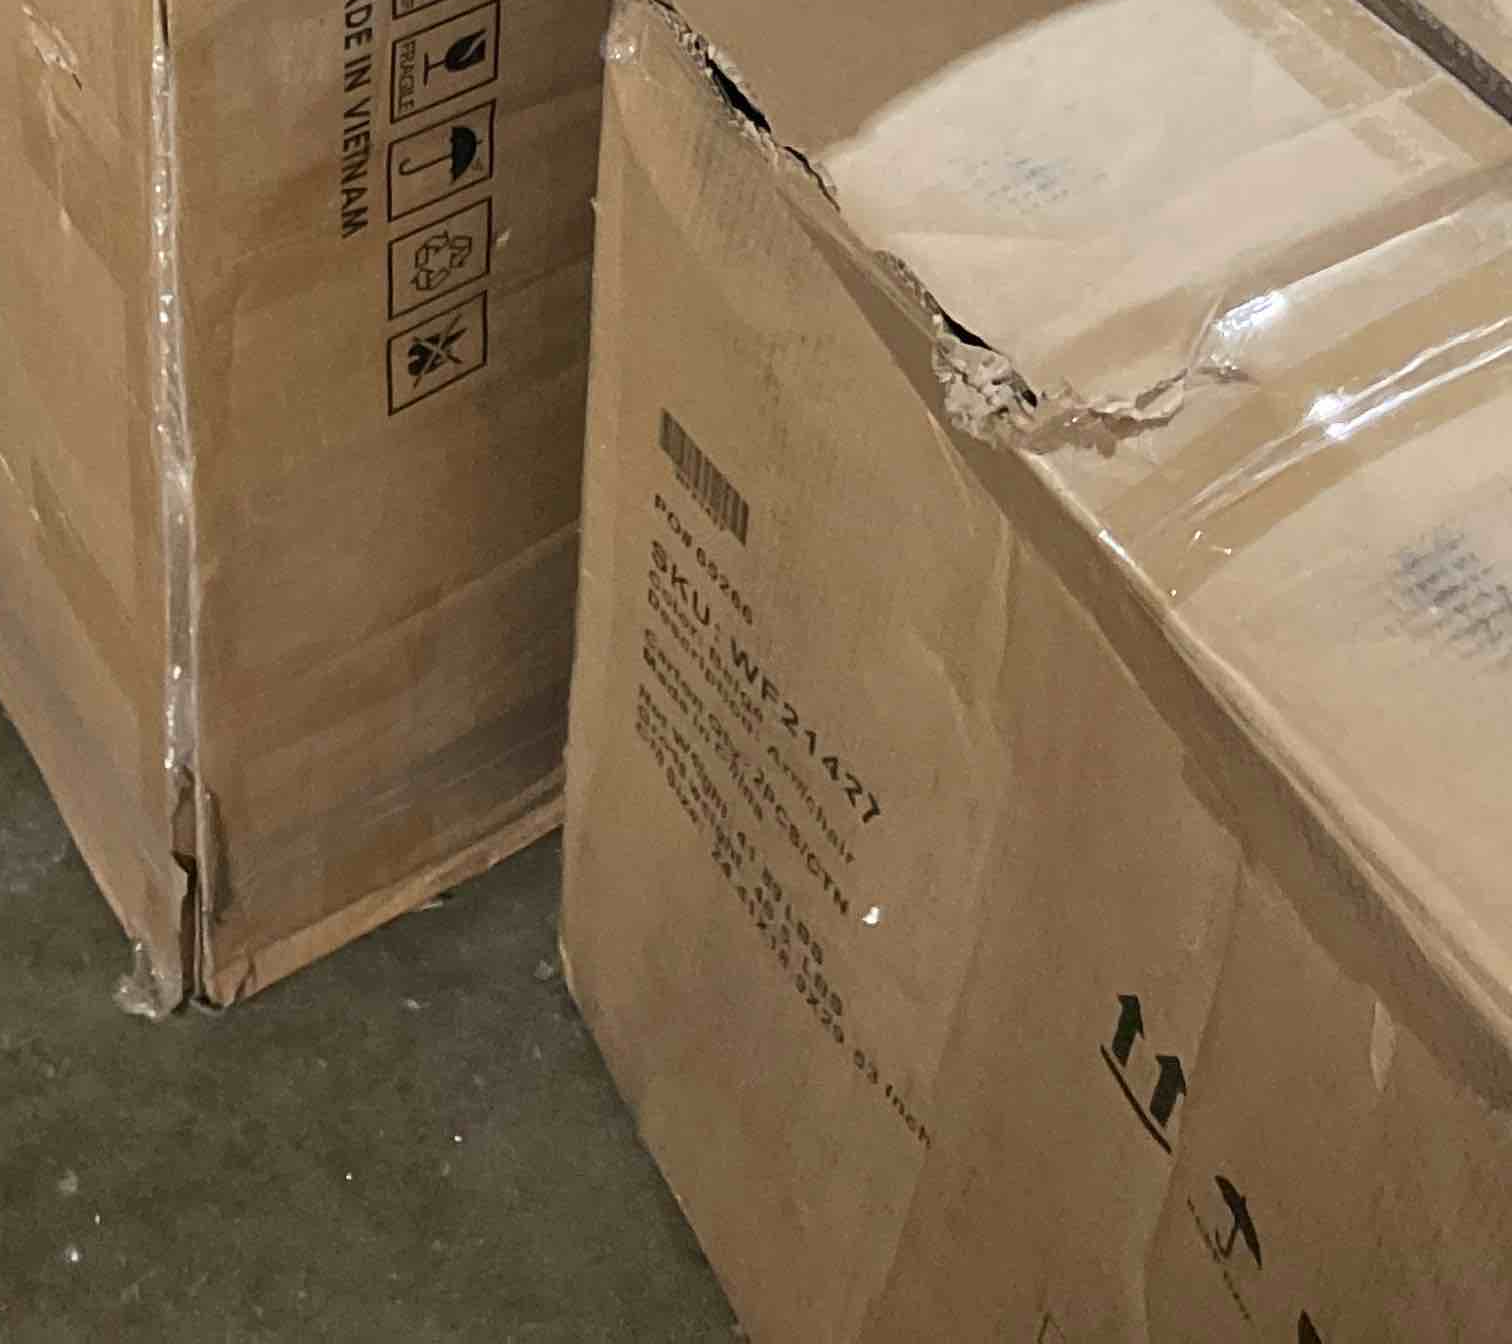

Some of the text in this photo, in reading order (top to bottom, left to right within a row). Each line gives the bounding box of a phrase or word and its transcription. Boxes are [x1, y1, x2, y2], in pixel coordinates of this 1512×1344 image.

[343, 54, 373, 92] IN
[398, 39, 417, 113] FRAGILE
[341, 96, 372, 239] VIETNAM
[643, 646, 688, 714] Made
[730, 636, 881, 823] WF21427
[767, 744, 855, 864] Armchair
